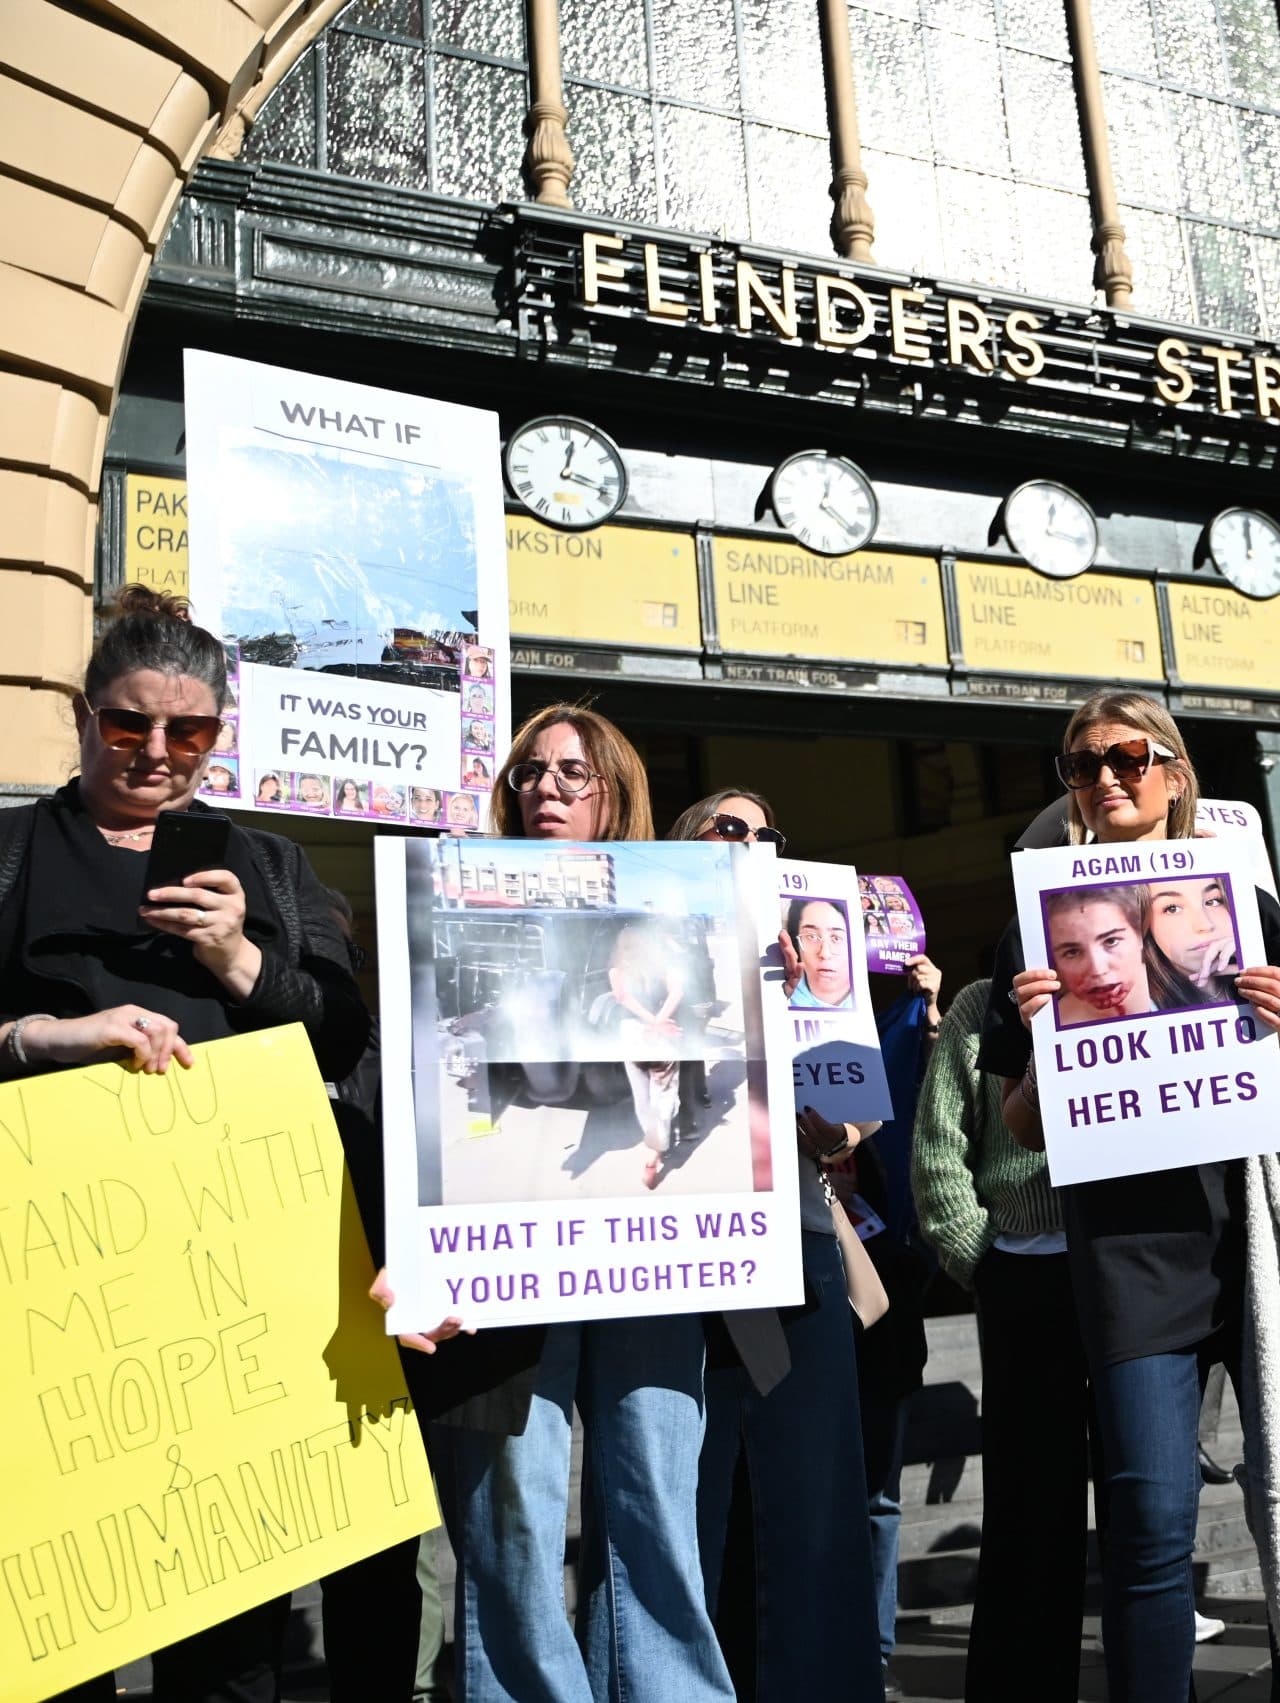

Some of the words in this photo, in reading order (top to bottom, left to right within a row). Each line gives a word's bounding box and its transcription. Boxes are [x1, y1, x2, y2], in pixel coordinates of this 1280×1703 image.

[581, 232, 1046, 378] FLINDERS
[280, 400, 385, 440] WHAT
[396, 422, 421, 445] IF
[727, 550, 894, 584] SANDRINGHAM
[728, 582, 779, 606] LINE
[969, 574, 1123, 607] WILLIAMSTOWN
[1181, 595, 1251, 618] ALTONA
[731, 618, 819, 640] PLATFORM
[971, 605, 1017, 626] LINE
[1182, 623, 1223, 643] LINE
[727, 666, 763, 680] NEXT
[767, 668, 808, 684] TRAIN
[812, 672, 838, 686] FOR
[1005, 684, 1040, 698] TRAIN
[280, 693, 301, 713] IT
[307, 696, 361, 720] WAS
[367, 705, 427, 729] YOUR
[280, 727, 427, 771] FAMILY?
[1071, 854, 1141, 878] AGAM
[1149, 851, 1195, 874] (19)
[892, 940, 919, 952] THEIR
[1055, 1029, 1152, 1073] LOOK
[1168, 1015, 1256, 1055] INTO
[82, 1050, 218, 1142] YOU
[1068, 1088, 1142, 1128] HER
[1159, 1071, 1258, 1114] EYES
[430, 1221, 539, 1254] WHAT
[556, 1219, 585, 1246] IF
[604, 1215, 679, 1243] THIS
[695, 1210, 768, 1239] WAS
[446, 1273, 539, 1304] YOUR
[558, 1259, 757, 1297] DAUGHTER?
[27, 1272, 148, 1375] ME
[38, 1313, 289, 1475] HOPE
[1, 1397, 409, 1661] HUMANITY
